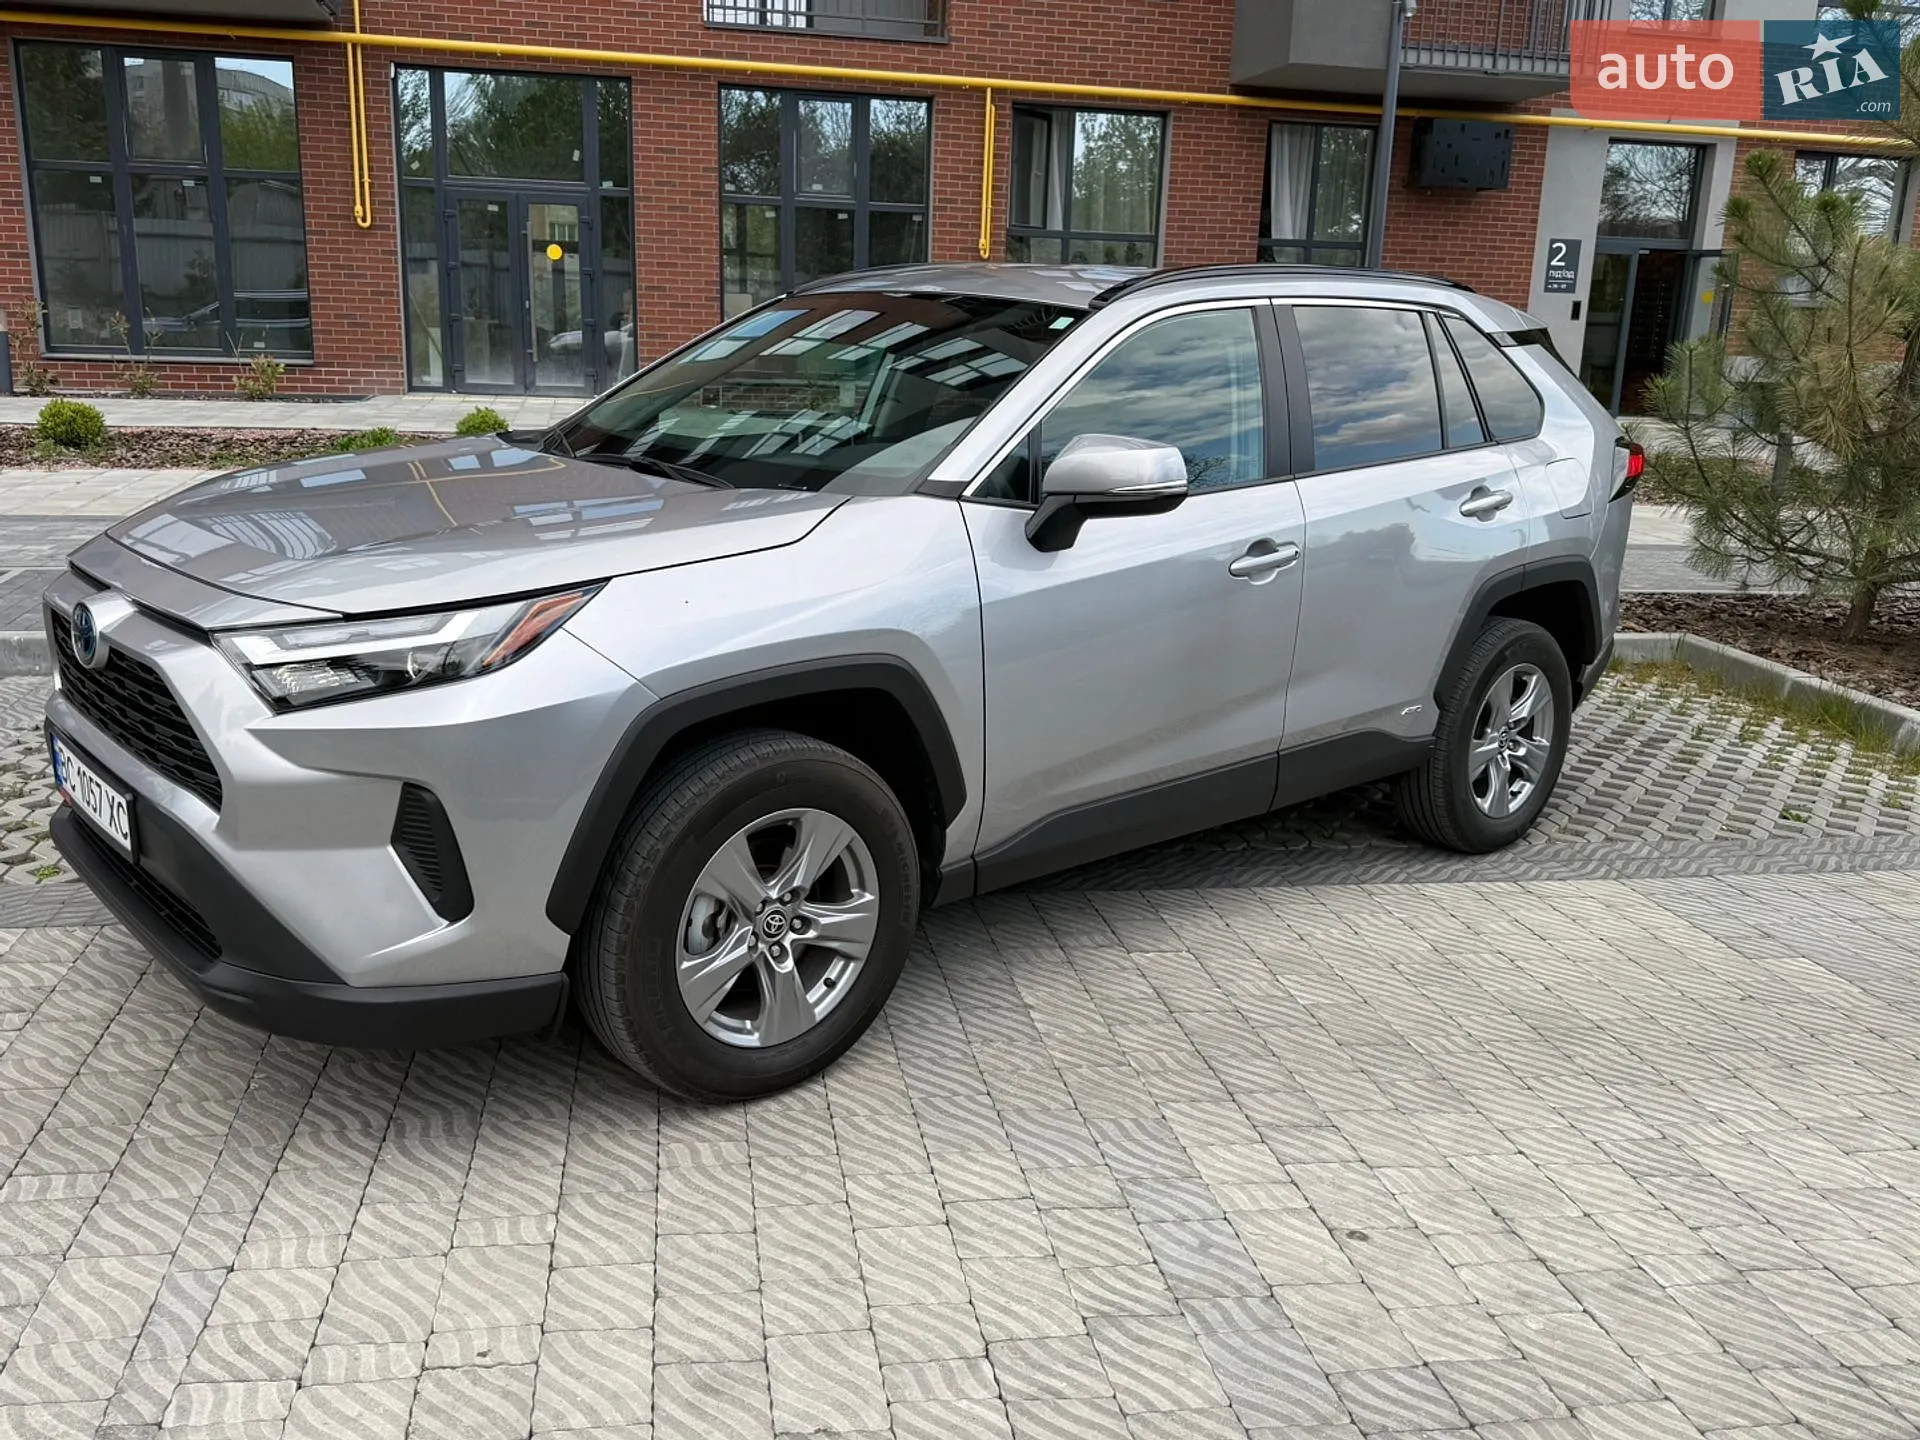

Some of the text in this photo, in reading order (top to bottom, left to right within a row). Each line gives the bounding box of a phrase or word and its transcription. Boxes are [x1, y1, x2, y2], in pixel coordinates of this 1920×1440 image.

[1550, 242, 1566, 266] 2
[77, 766, 103, 819] 1057
[105, 789, 128, 841] XC
